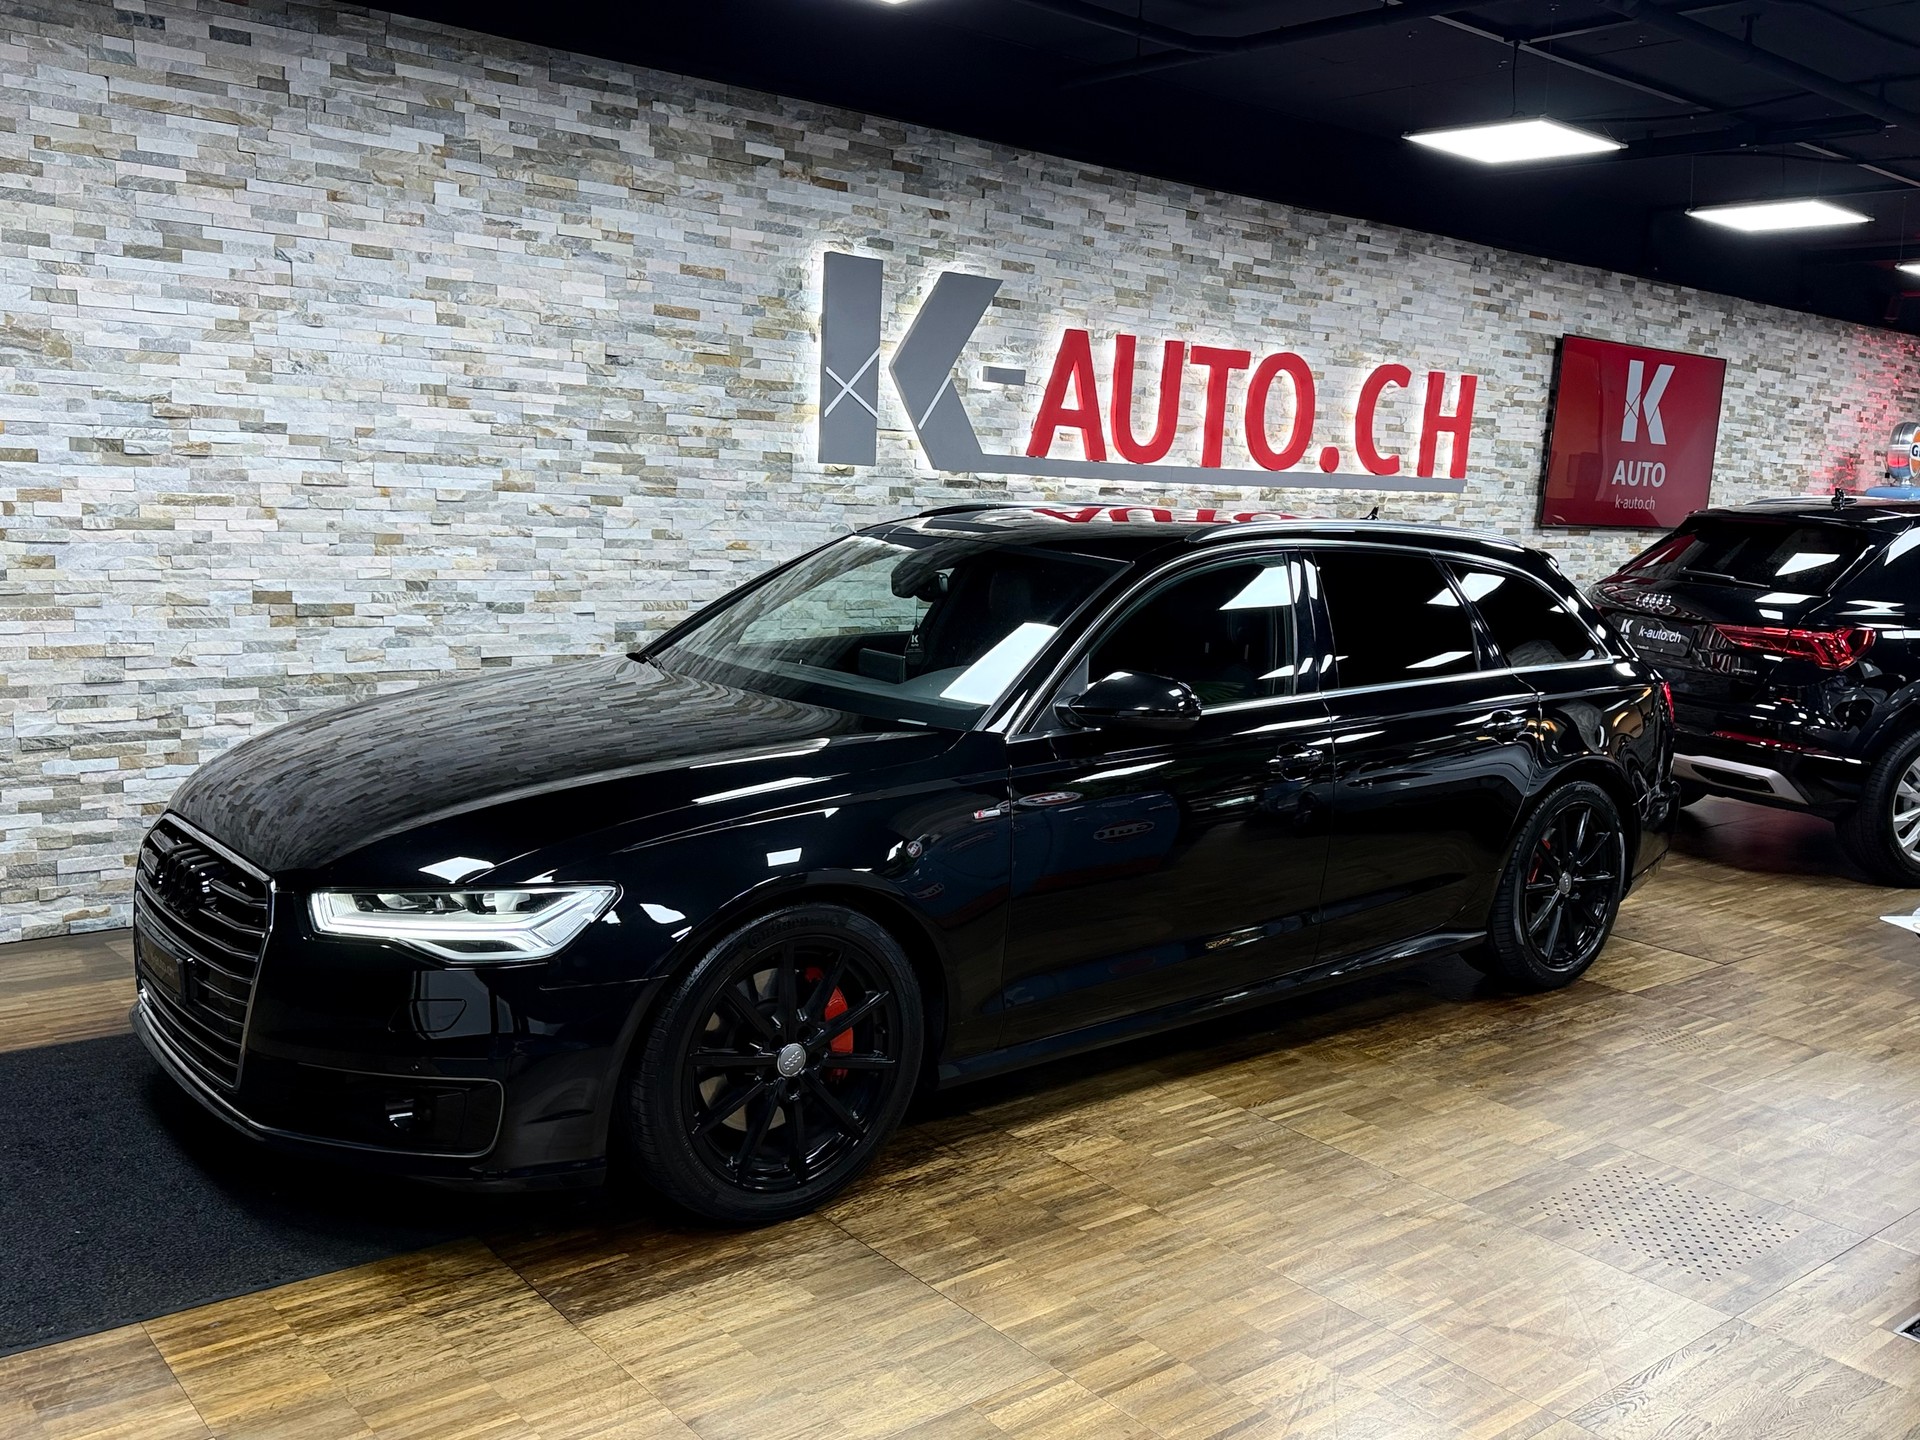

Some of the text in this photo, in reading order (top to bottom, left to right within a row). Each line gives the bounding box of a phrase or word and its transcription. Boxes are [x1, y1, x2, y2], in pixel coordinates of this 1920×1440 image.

[819, 252, 1477, 480] K-AUTO.CH
[1621, 359, 1676, 446] K
[1611, 460, 1666, 488] AUTO
[1615, 494, 1656, 510] k-auto.ch
[1620, 618, 1634, 634] K
[1638, 625, 1682, 644] k-auto.ch
[911, 634, 919, 643] K
